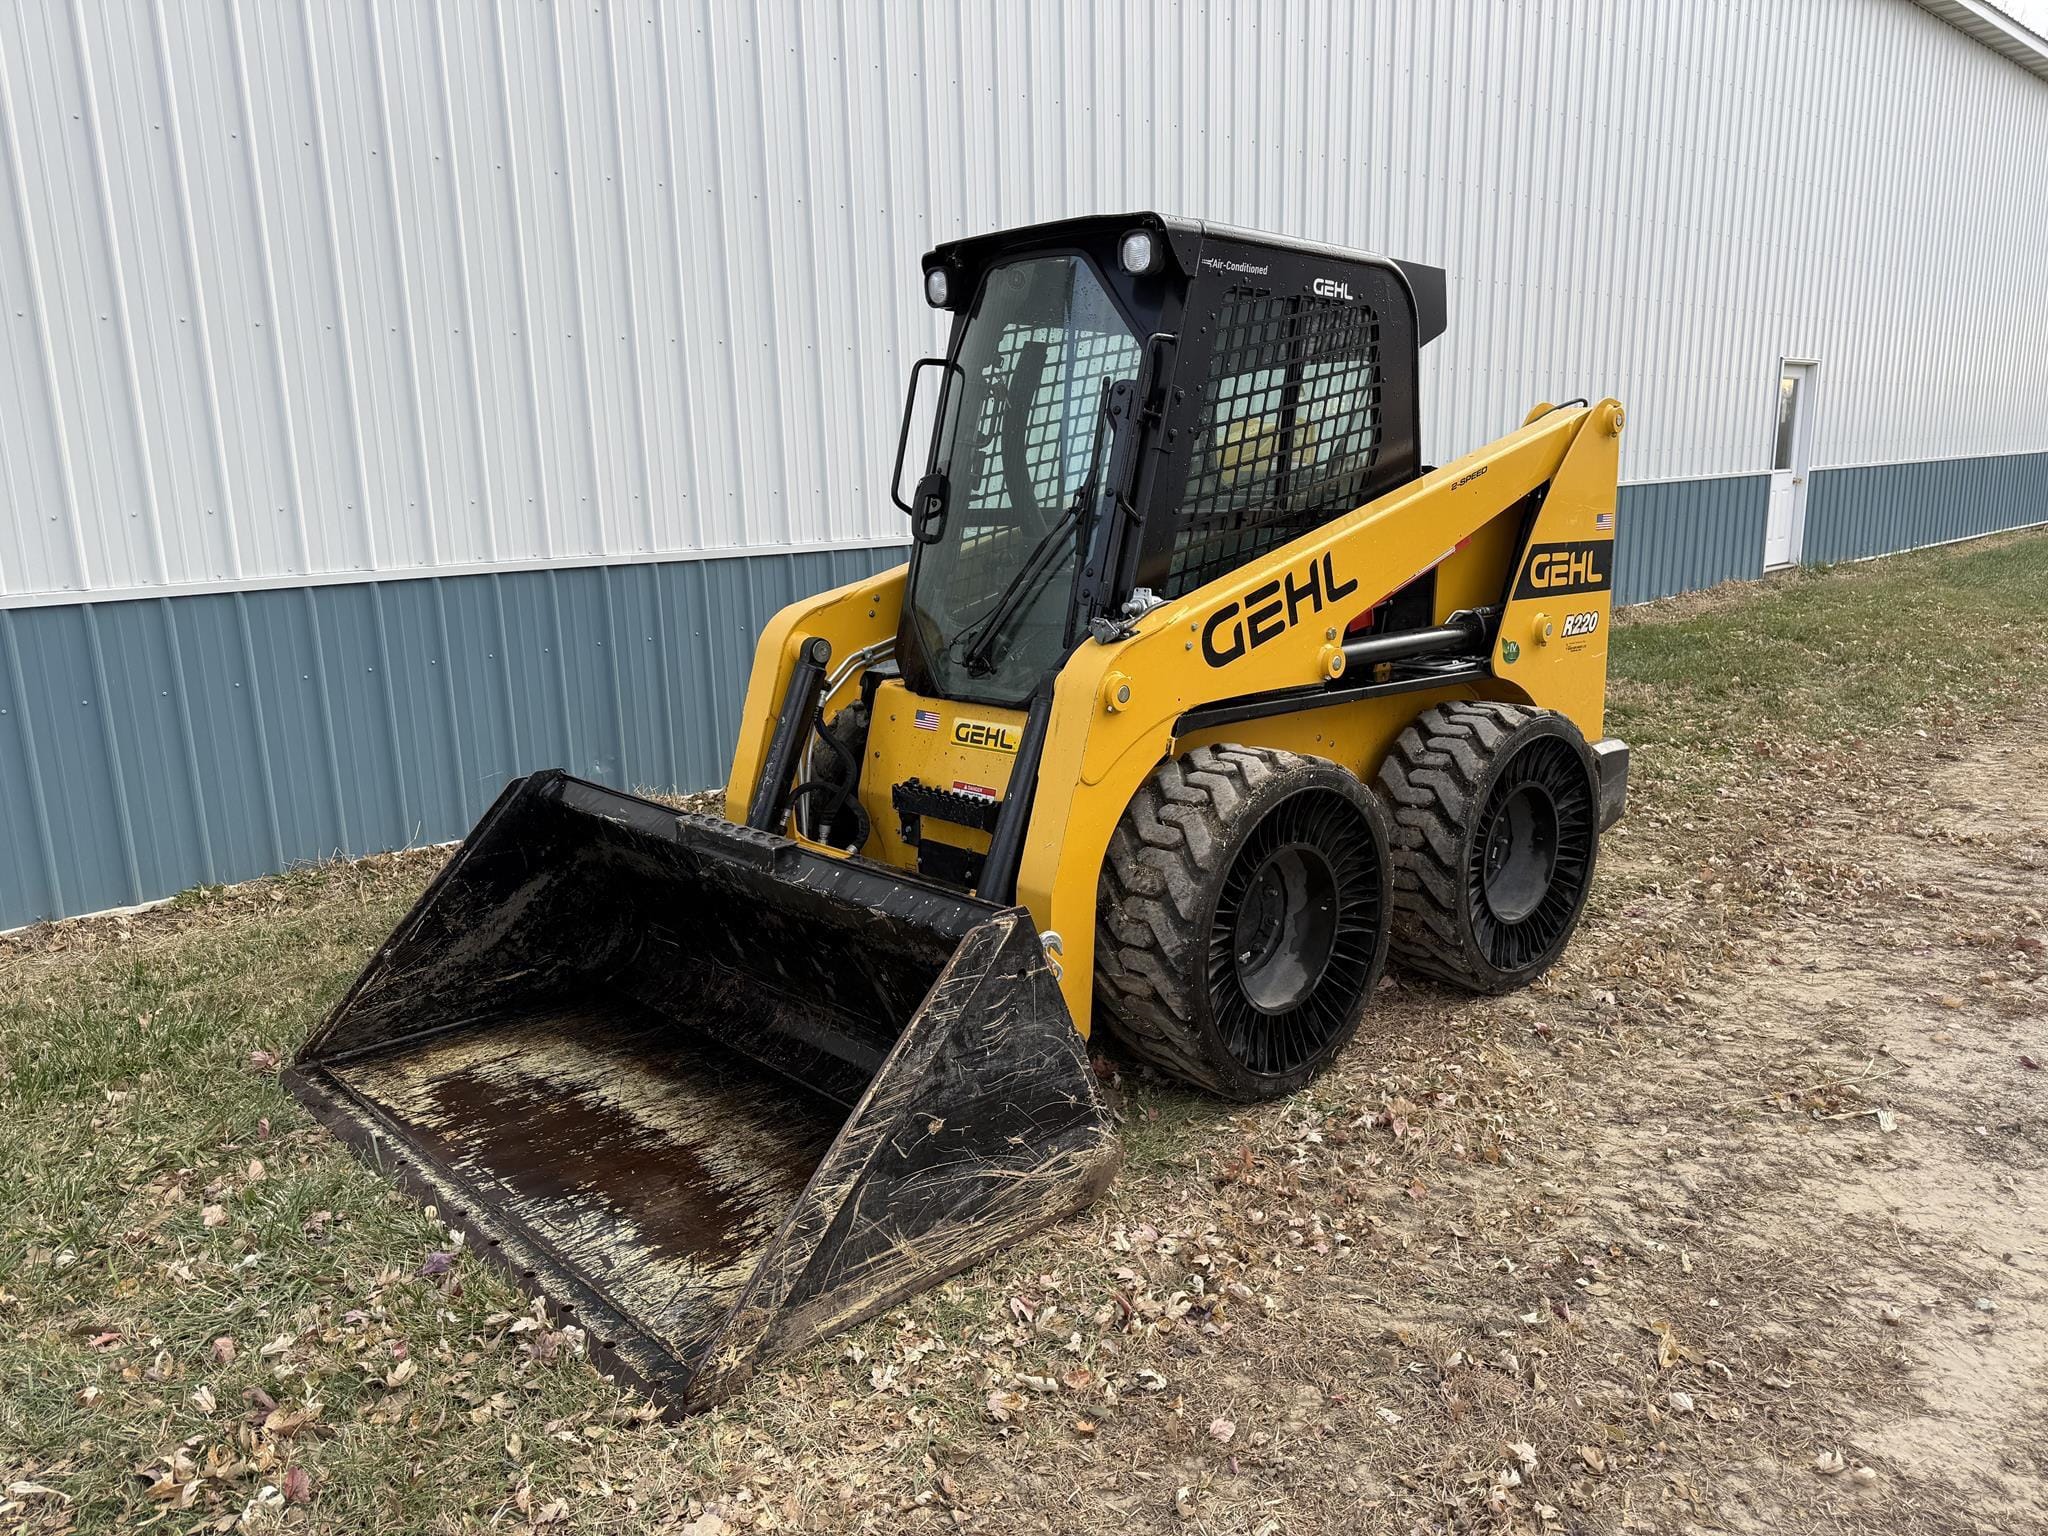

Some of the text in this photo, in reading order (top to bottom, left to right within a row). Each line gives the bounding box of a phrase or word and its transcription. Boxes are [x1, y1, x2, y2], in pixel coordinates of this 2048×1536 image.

[1212, 259, 1268, 275] Air-Conditioned
[1313, 278, 1353, 299] GEHL
[1450, 466, 1488, 490] 2-SPEED
[1530, 550, 1602, 588] GEHL
[1202, 551, 1358, 668] GEHL
[1561, 611, 1599, 638] R220
[956, 723, 1013, 749] GEHL
